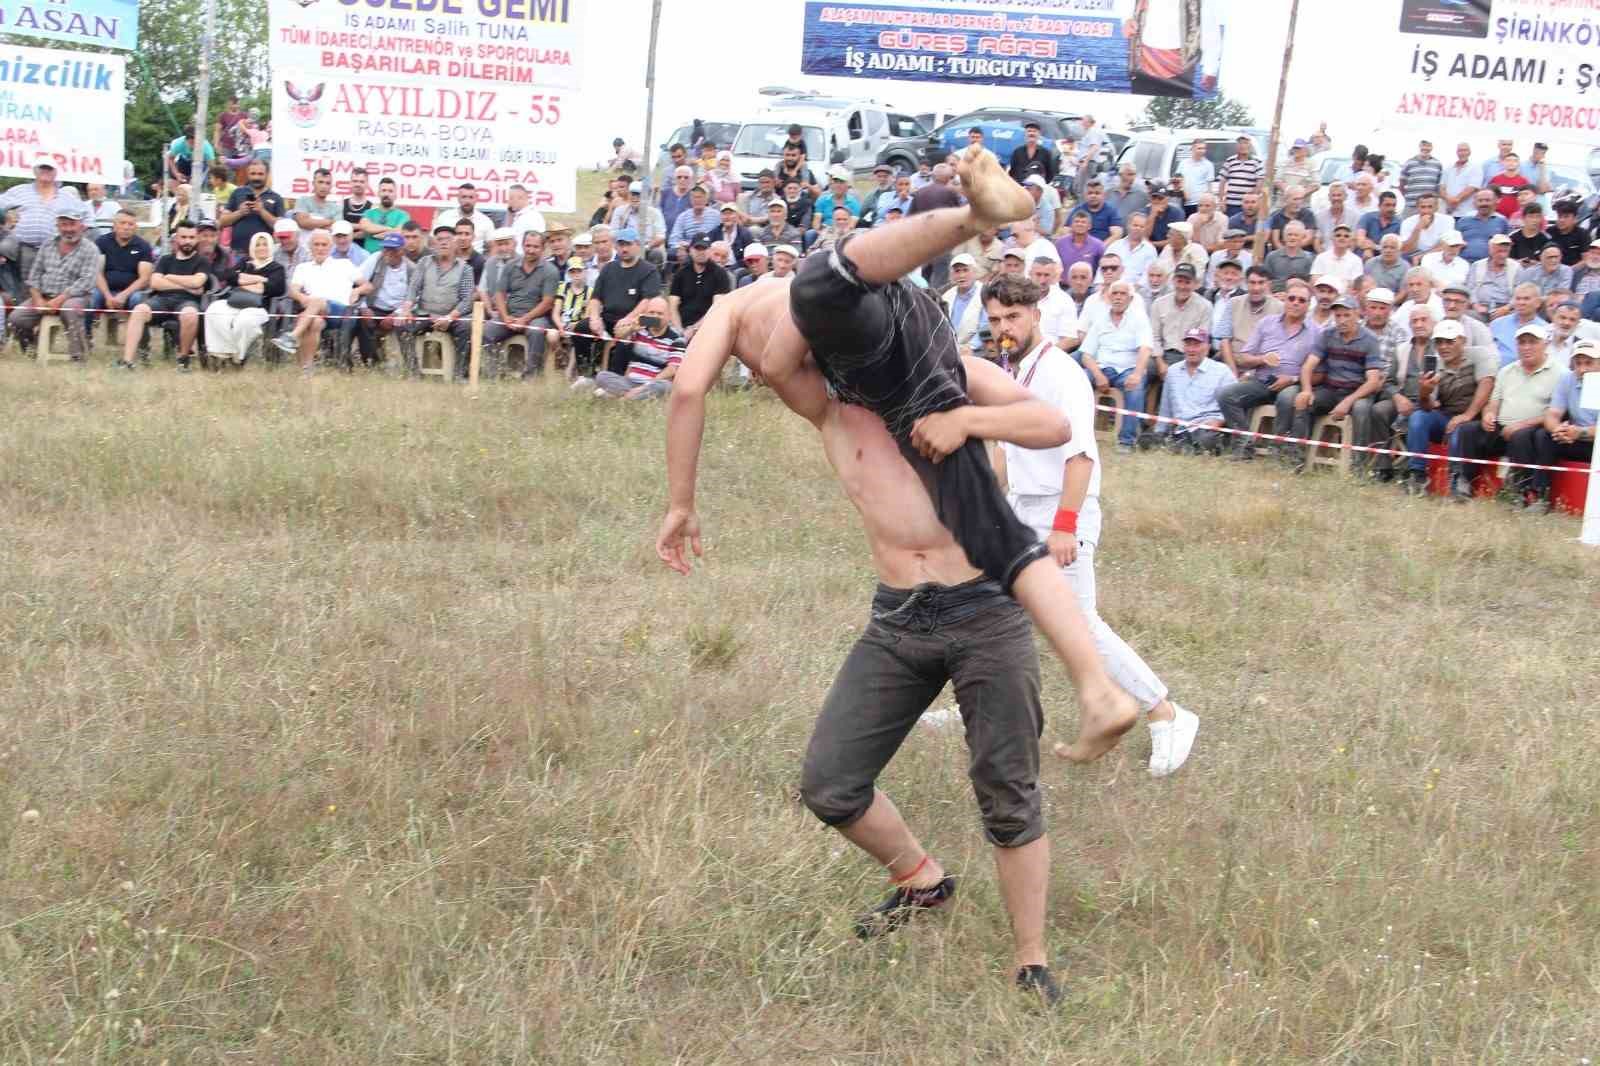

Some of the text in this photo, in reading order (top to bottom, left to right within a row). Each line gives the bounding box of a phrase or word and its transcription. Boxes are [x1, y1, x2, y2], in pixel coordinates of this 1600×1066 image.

[14, 5, 119, 40] ASAN
[365, 15, 416, 30] ADAMI
[424, 18, 470, 36] Salih
[477, 22, 529, 41] TUNA
[280, 24, 311, 45] TÜM
[458, 45, 473, 57] ve
[478, 44, 571, 65] SPORCULARA
[879, 28, 1058, 58] GÜREŞ AĞASI
[321, 51, 534, 83] BAŞARILAR DİLERİM
[844, 47, 865, 74] İŞ
[866, 52, 934, 72] ADAMI
[946, 56, 1031, 78] TURGUT
[1032, 59, 1098, 84] ŞAHİN
[1411, 44, 1439, 81] İŞ
[1449, 53, 1546, 84] ADAMI
[0, 101, 53, 123] RAN
[331, 83, 497, 121] AYYILDIZ
[529, 94, 561, 126] 55
[1396, 92, 1600, 131] ANTRENÖR ve SPORCU
[0, 126, 40, 145] ARA
[359, 119, 425, 139] RASPA
[0, 142, 103, 175] İLRİM
[388, 141, 430, 158] TURAN
[365, 162, 539, 184] SPORCULARA
